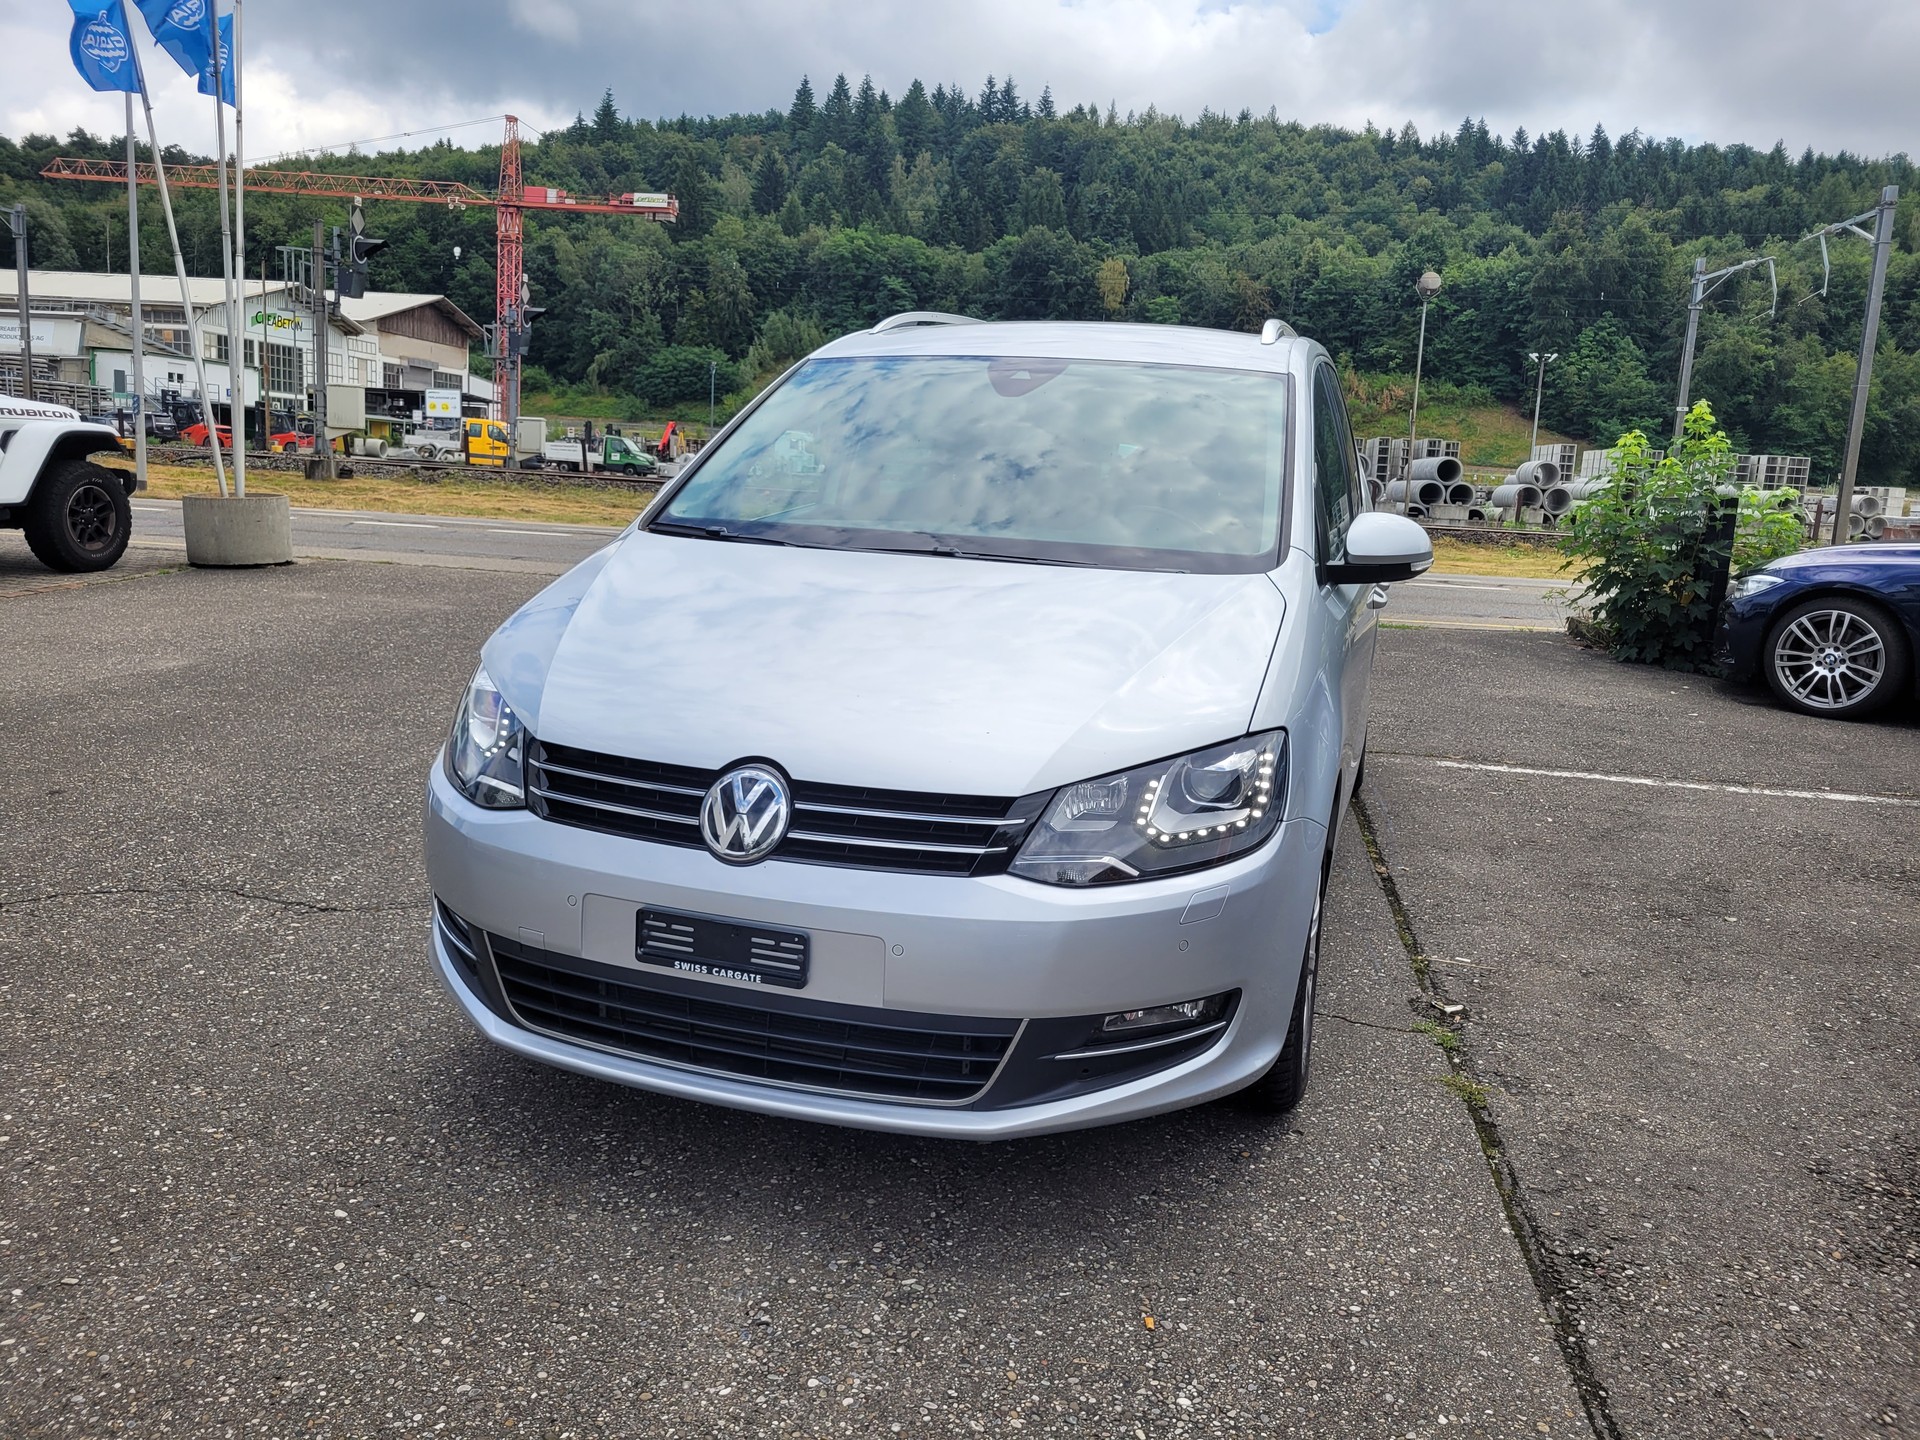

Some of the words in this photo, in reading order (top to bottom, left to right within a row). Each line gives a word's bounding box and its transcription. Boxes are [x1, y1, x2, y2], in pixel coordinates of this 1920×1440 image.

[0, 402, 75, 419] RUBICON
[674, 960, 708, 974] SWISS
[712, 967, 762, 984] CARGATE
